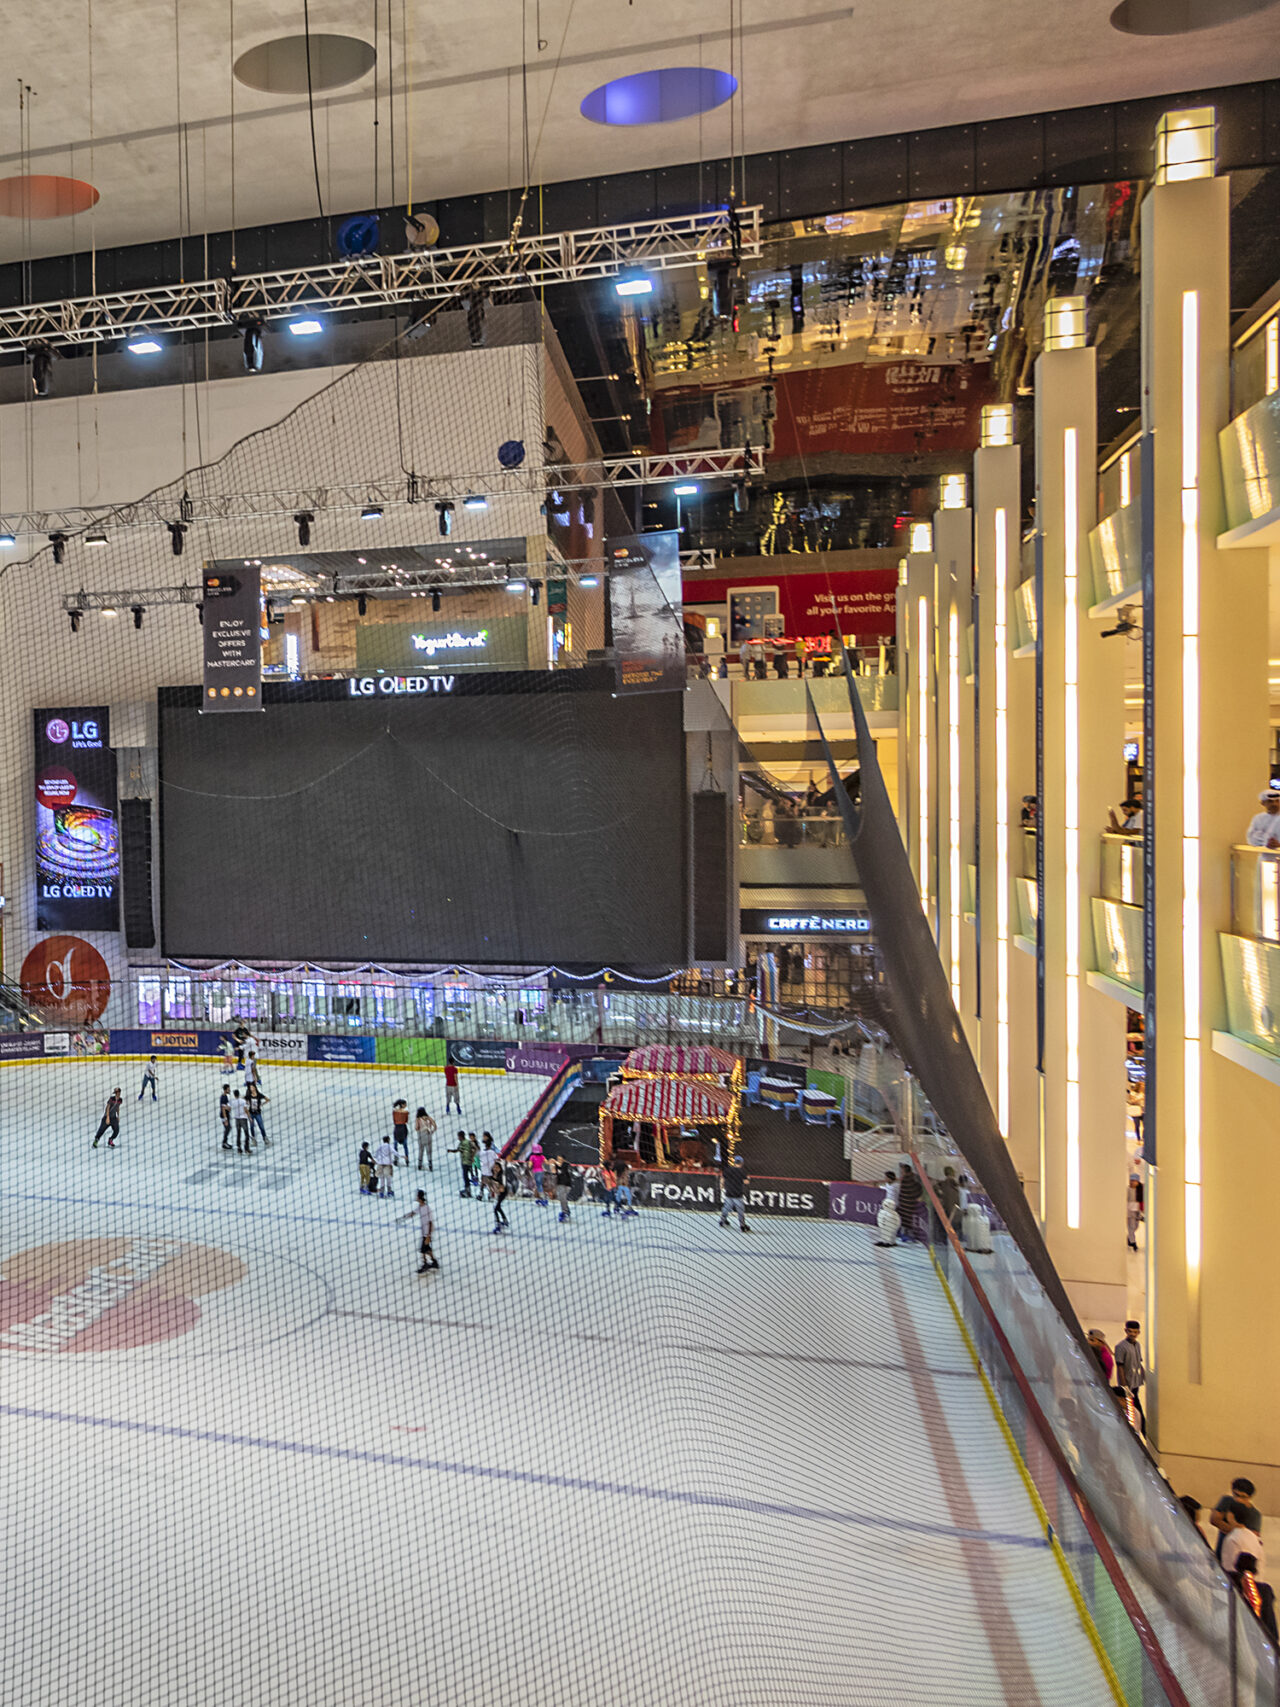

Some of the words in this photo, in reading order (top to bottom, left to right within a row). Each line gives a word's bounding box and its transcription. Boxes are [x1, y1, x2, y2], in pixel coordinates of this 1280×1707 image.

[837, 594, 848, 602] us
[865, 592, 882, 601] the
[807, 606, 818, 615] all
[844, 604, 881, 613] favorite
[212, 629, 251, 638] EXCLUSIVE
[218, 640, 246, 648] OFFERS
[349, 677, 375, 696] LG
[379, 676, 429, 694] OLED
[429, 675, 455, 692] TV
[72, 720, 99, 740] LG
[43, 885, 61, 899] LG
[821, 919, 870, 930] NERO
[163, 1033, 196, 1046] JOTUN
[261, 1038, 305, 1049] TISSOT
[650, 1182, 716, 1203] FOAM
